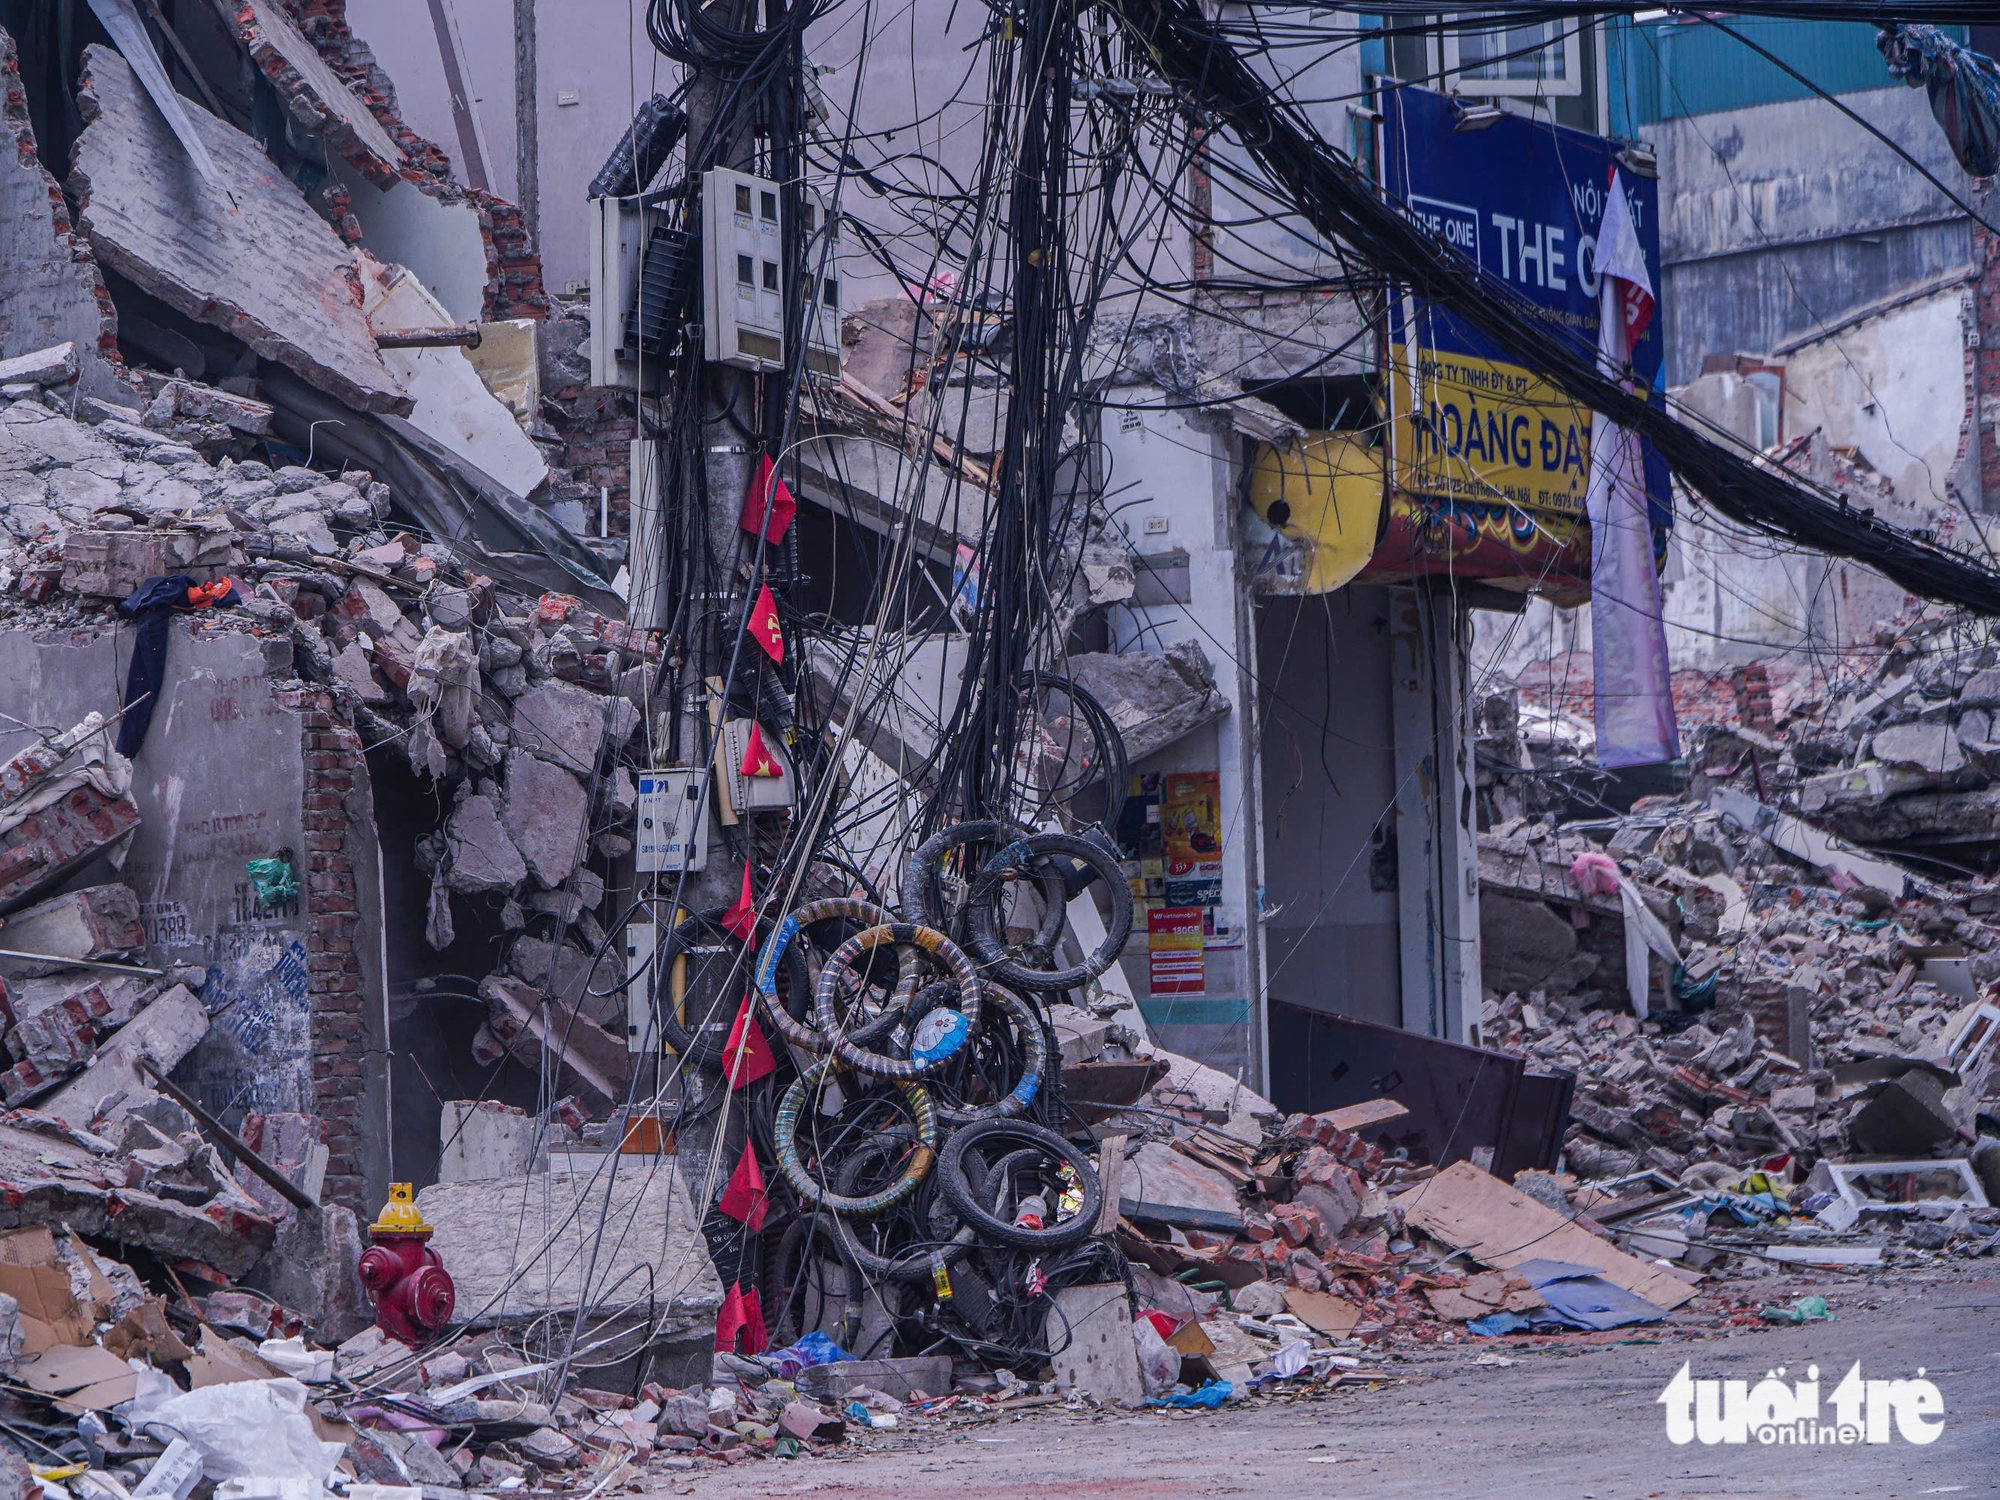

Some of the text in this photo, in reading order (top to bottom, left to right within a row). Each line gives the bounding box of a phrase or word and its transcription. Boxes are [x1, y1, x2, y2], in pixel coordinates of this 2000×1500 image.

[1573, 178, 1601, 223] NỘI
[1445, 218, 1475, 249] ONE
[1492, 212, 1567, 292] THE
[1445, 364, 1458, 383] TY
[1461, 367, 1489, 389] TNHH
[1506, 376, 1514, 393] &
